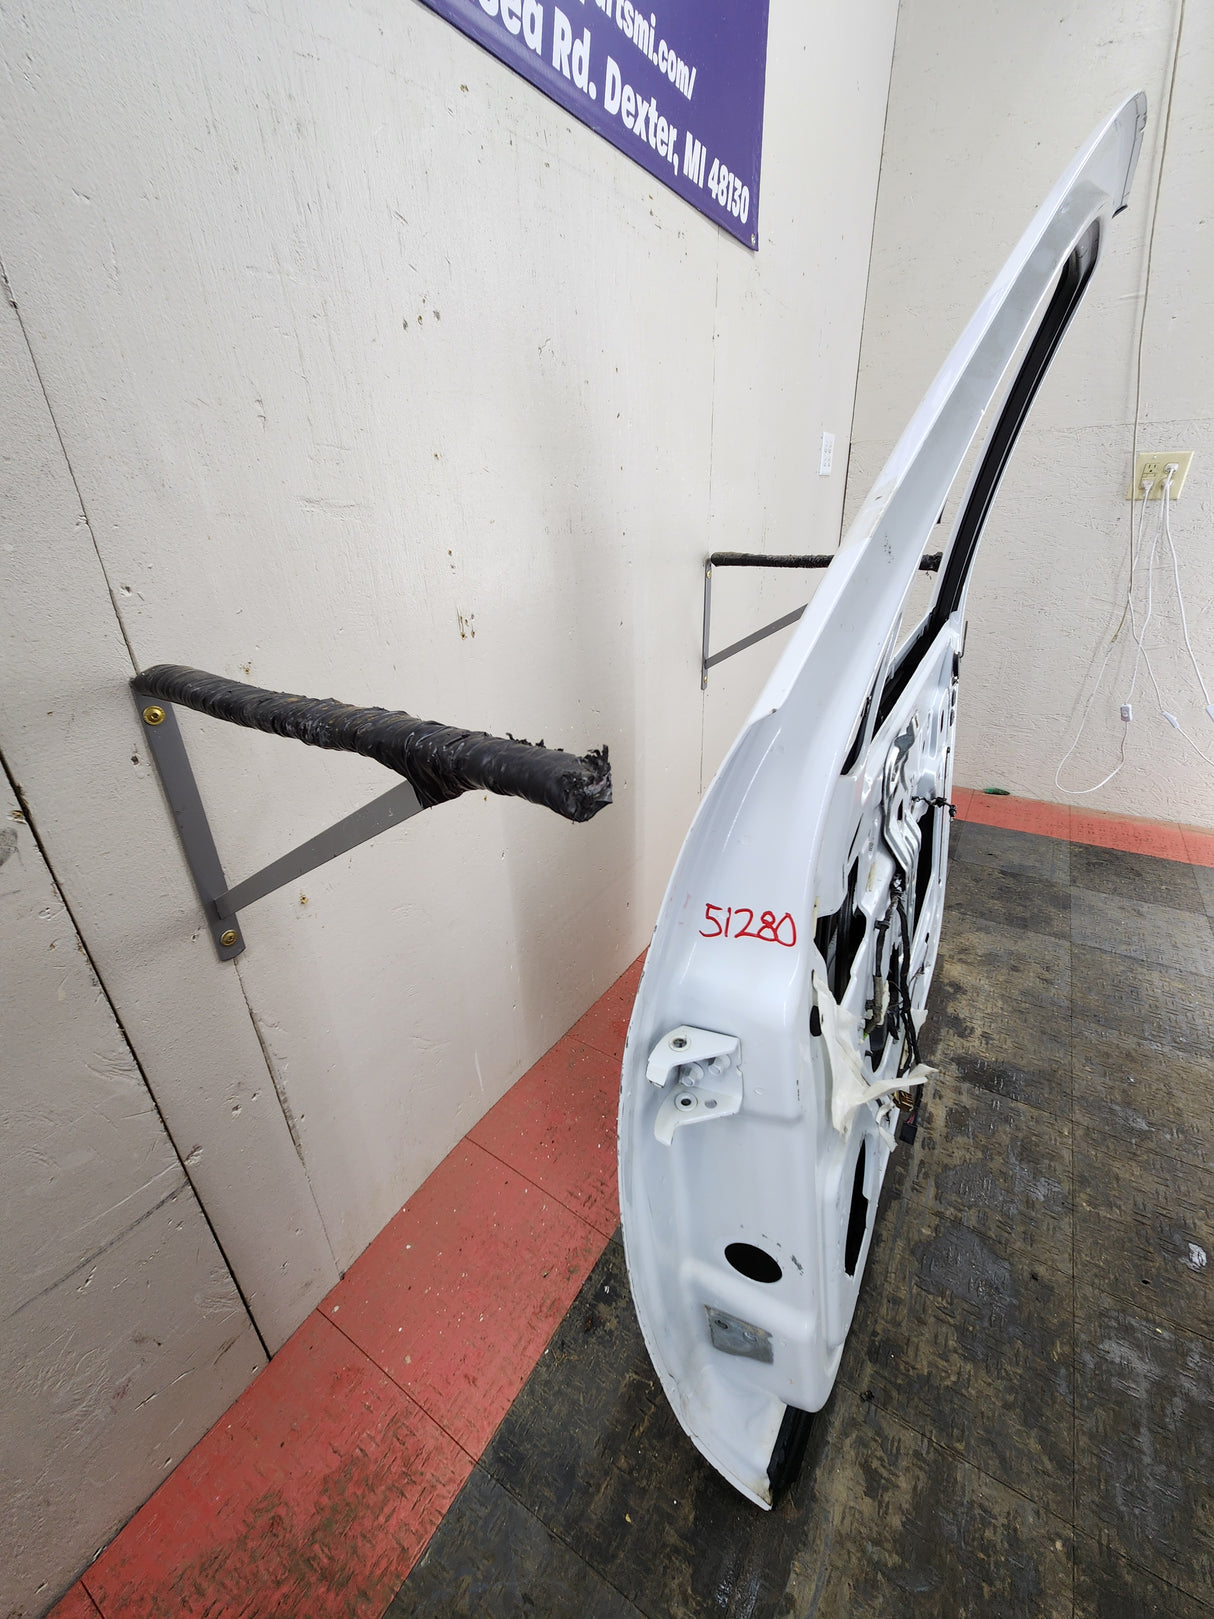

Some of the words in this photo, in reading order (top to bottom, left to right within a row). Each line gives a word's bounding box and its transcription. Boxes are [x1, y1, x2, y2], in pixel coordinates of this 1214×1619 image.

[552, 6, 597, 100] Rd.
[604, 55, 679, 176] Dexter,
[683, 130, 707, 189] MI
[707, 157, 750, 224] 48130
[699, 902, 797, 947] 51280
